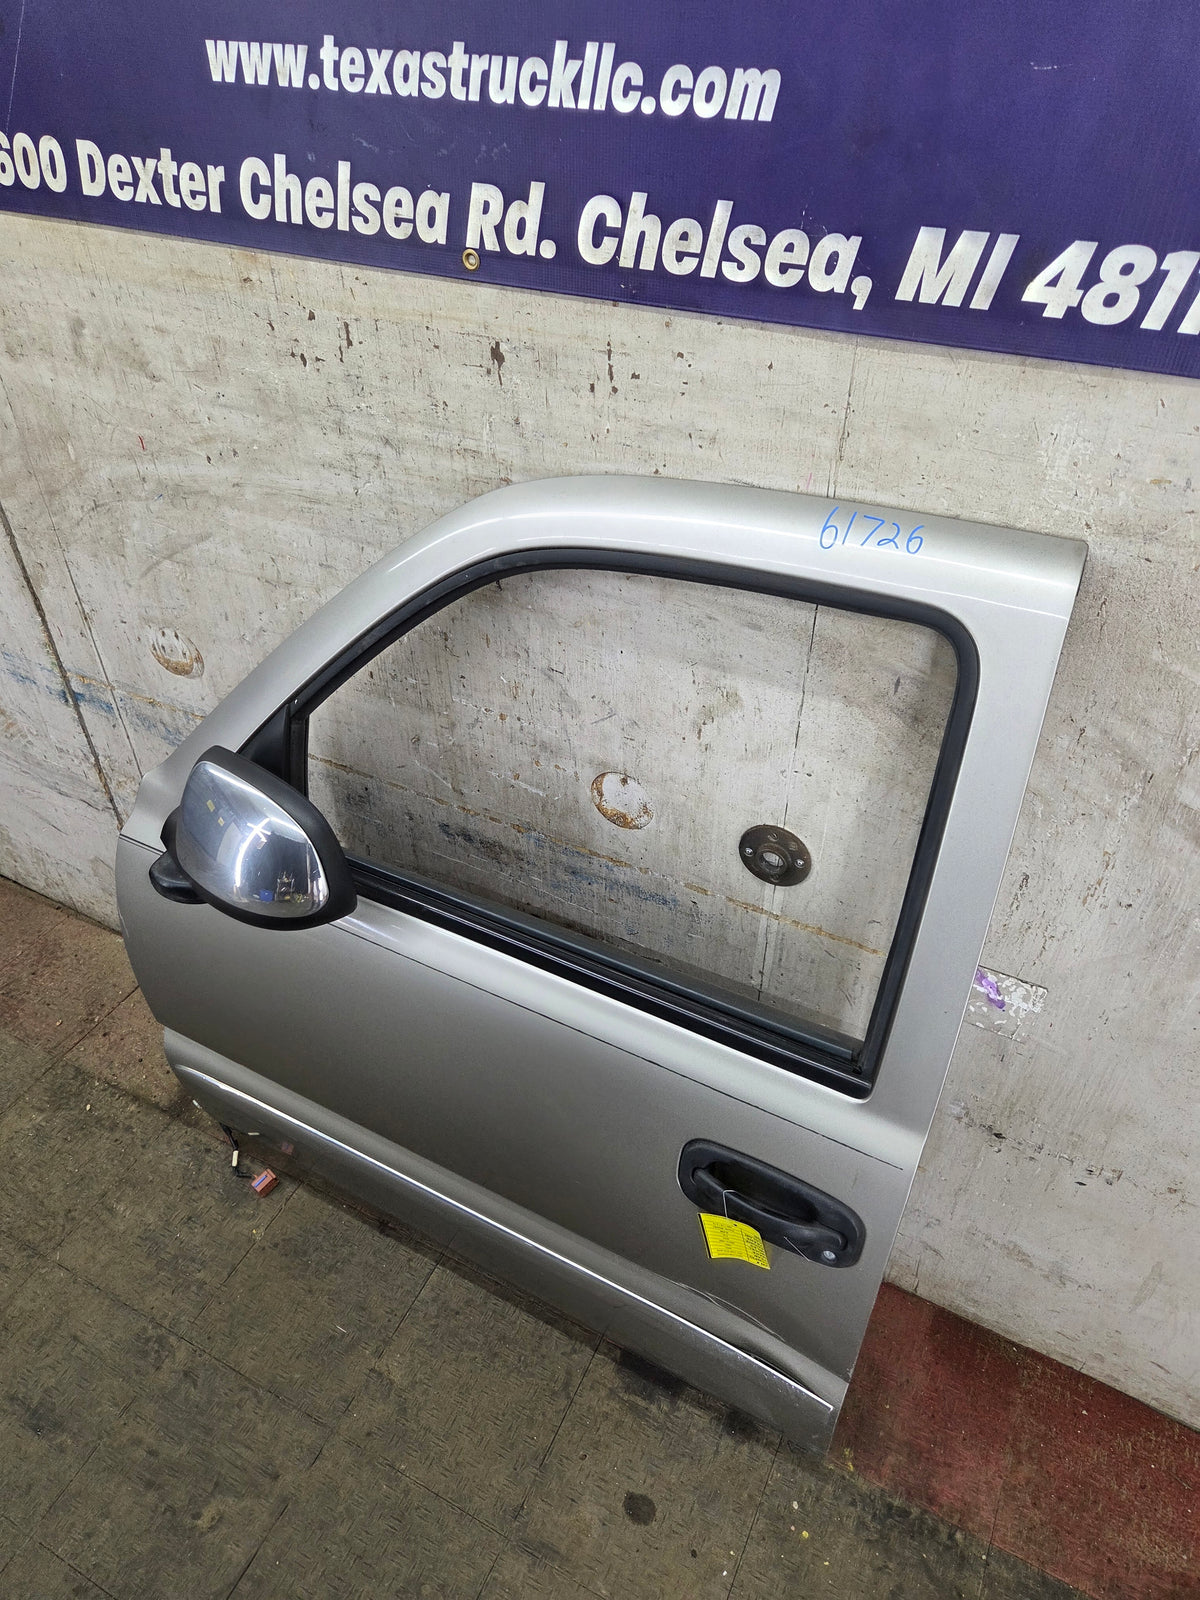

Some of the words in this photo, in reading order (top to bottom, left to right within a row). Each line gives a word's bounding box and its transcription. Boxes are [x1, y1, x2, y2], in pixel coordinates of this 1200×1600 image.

[205, 34, 781, 121] www.texastruckllc.com
[75, 138, 226, 213] Dexter
[239, 154, 450, 244] Chelsea
[466, 181, 557, 259] Rd.
[577, 192, 873, 311] Chelsea,
[895, 226, 1020, 311] MI
[819, 506, 925, 554] 61726
